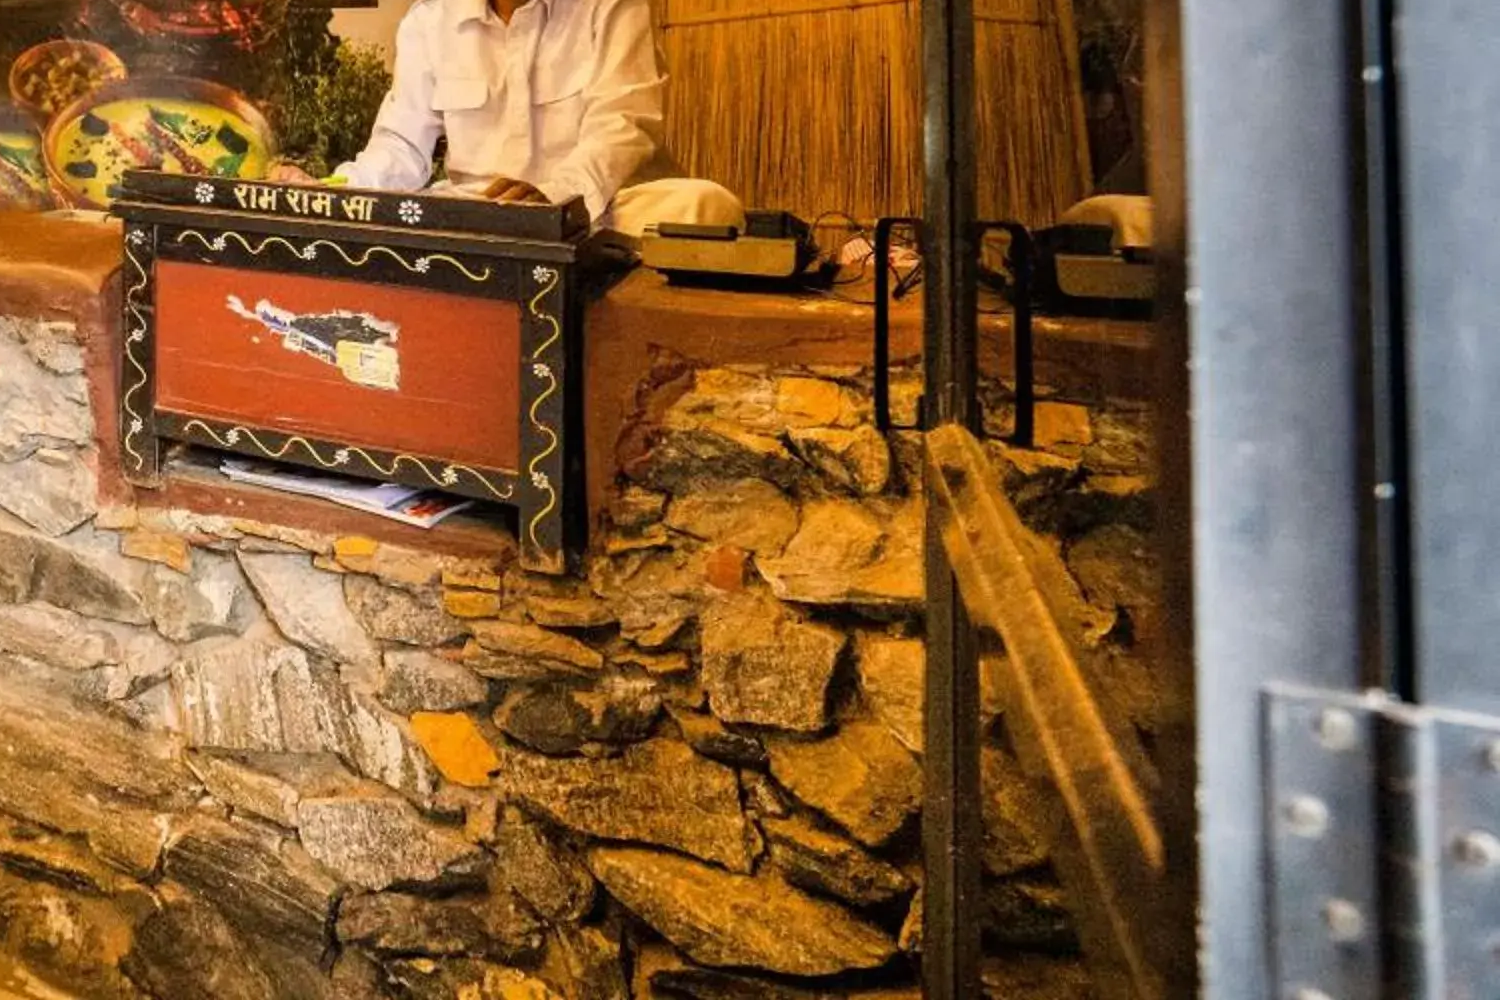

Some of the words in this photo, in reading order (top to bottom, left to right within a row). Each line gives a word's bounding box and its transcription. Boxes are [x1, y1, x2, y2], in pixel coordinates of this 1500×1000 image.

[234, 183, 283, 211] राम
[285, 188, 336, 217] राम
[341, 195, 379, 221] सा
